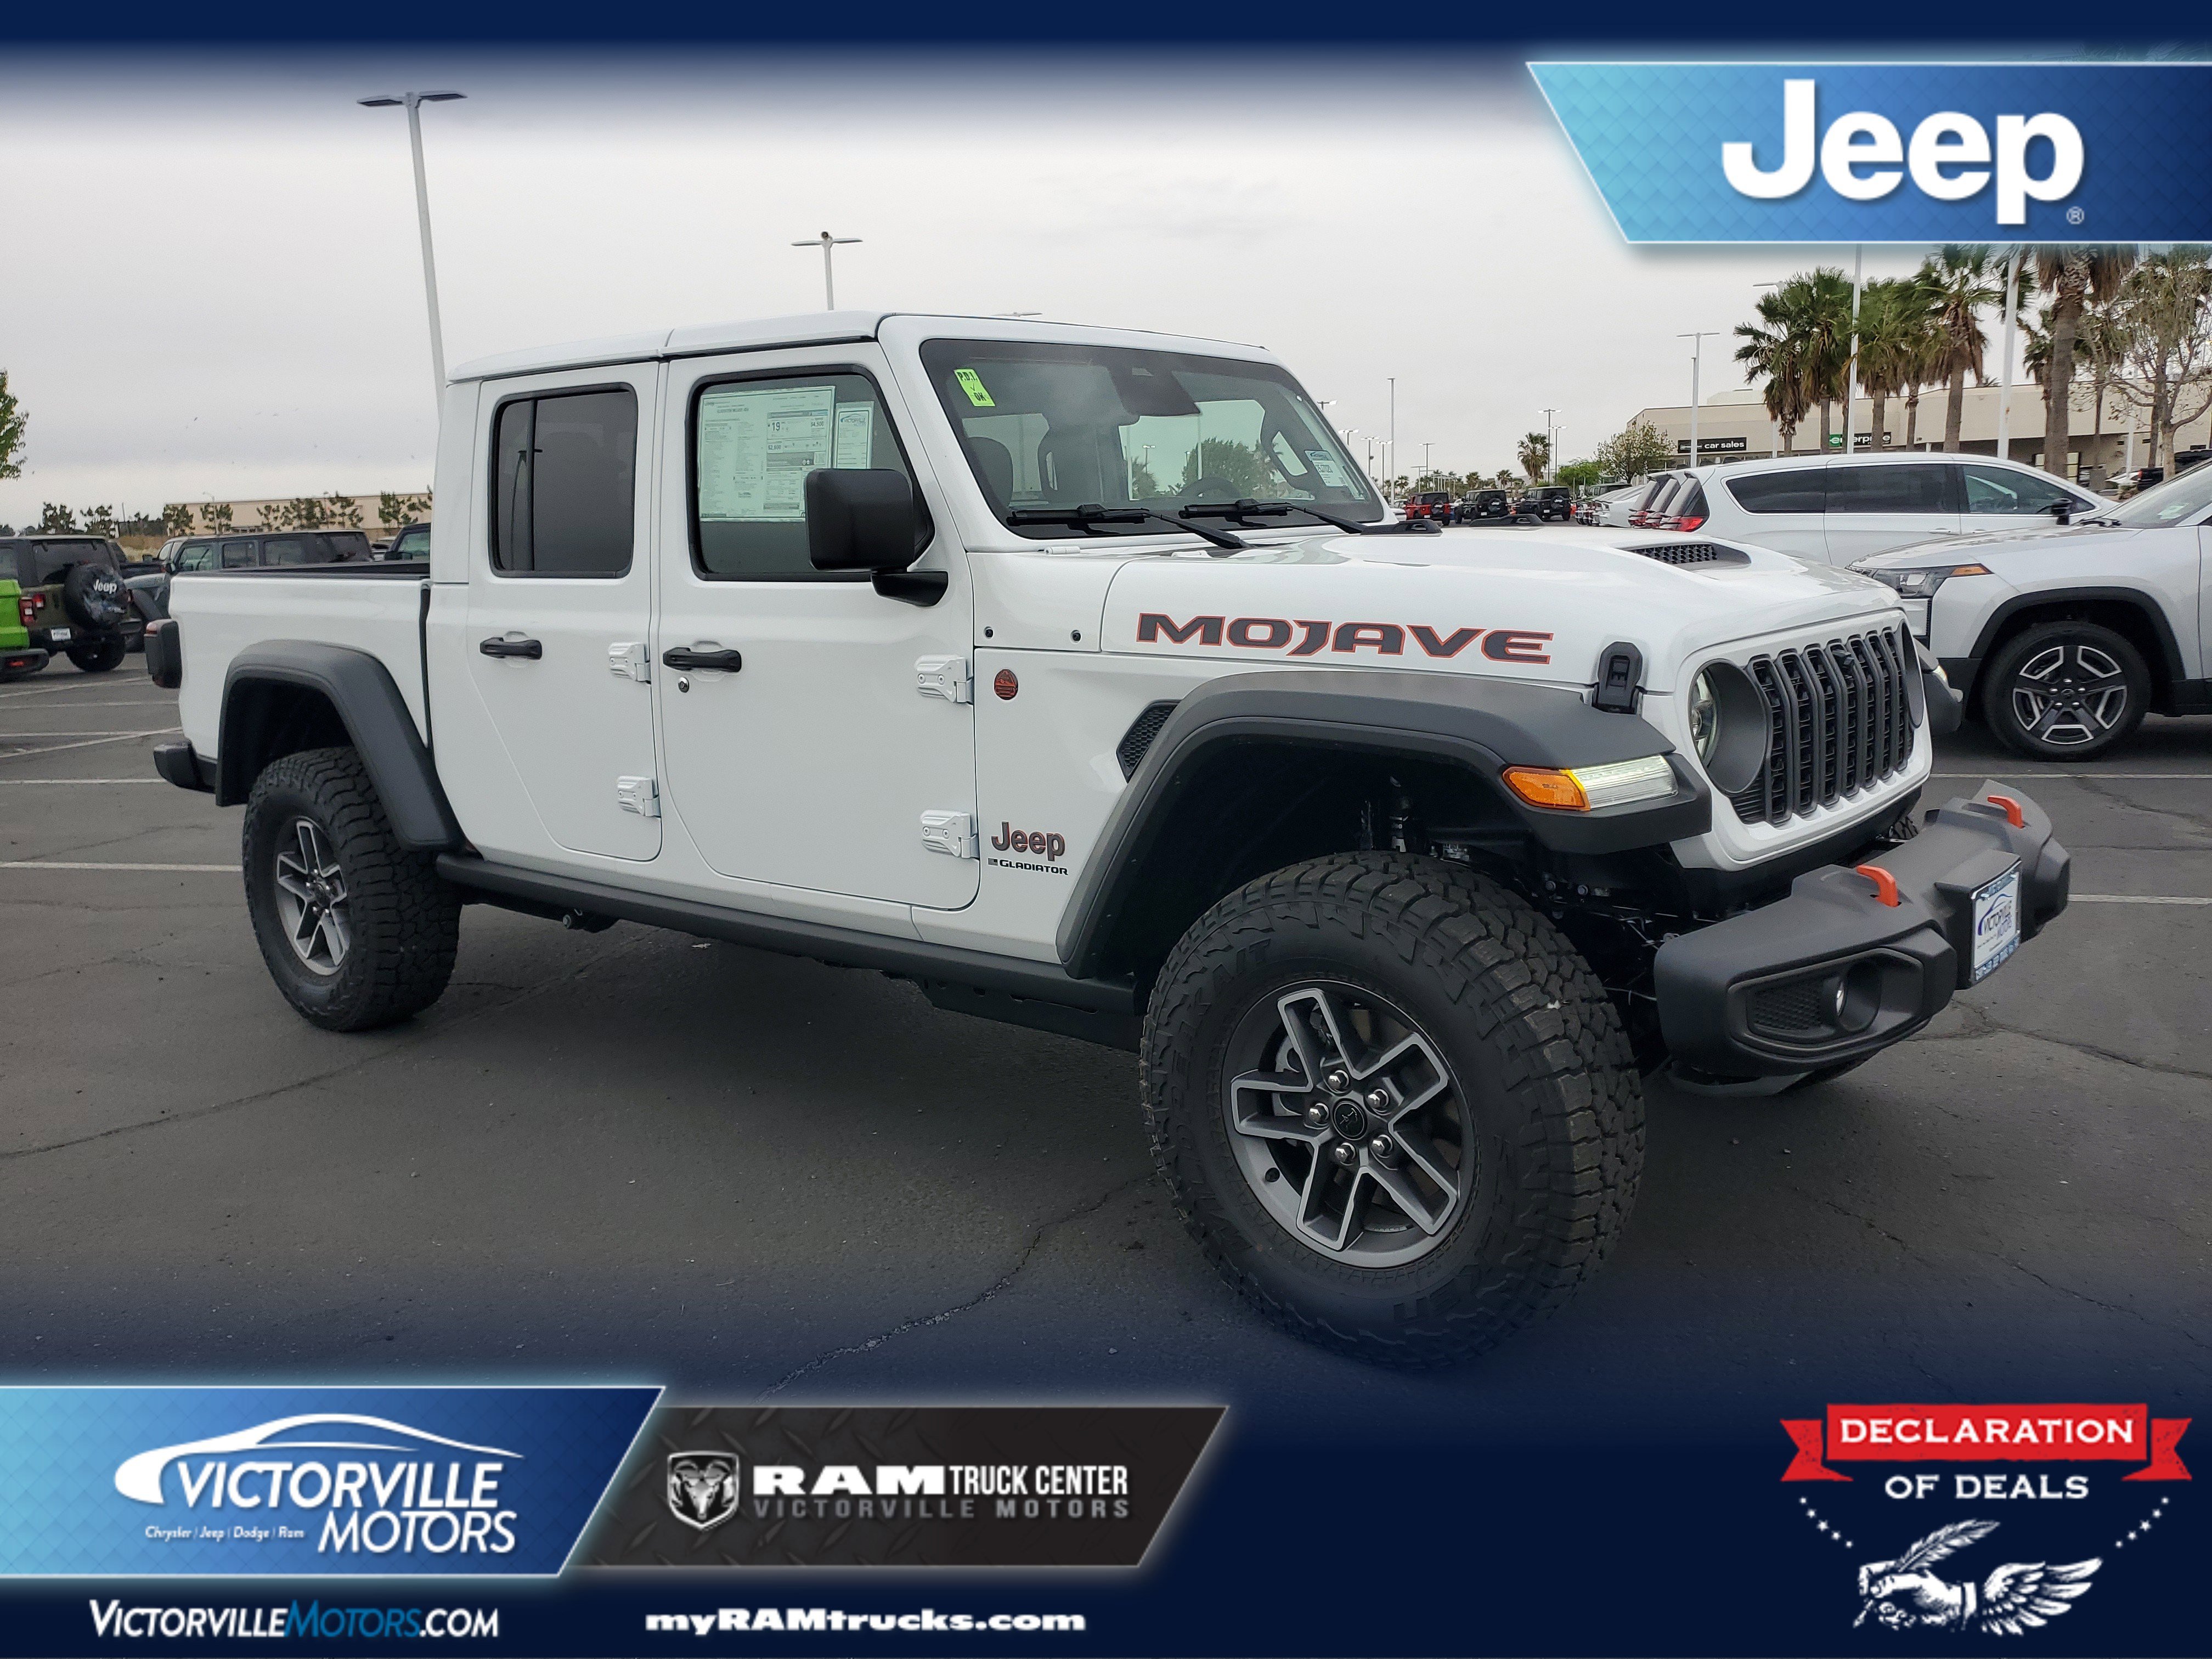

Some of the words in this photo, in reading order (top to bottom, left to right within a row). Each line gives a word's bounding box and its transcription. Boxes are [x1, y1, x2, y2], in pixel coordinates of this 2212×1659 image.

[1136, 613, 1554, 665] MOJAVE
[991, 821, 1065, 862] Jeep
[1000, 859, 1069, 876] GLADIATOR
